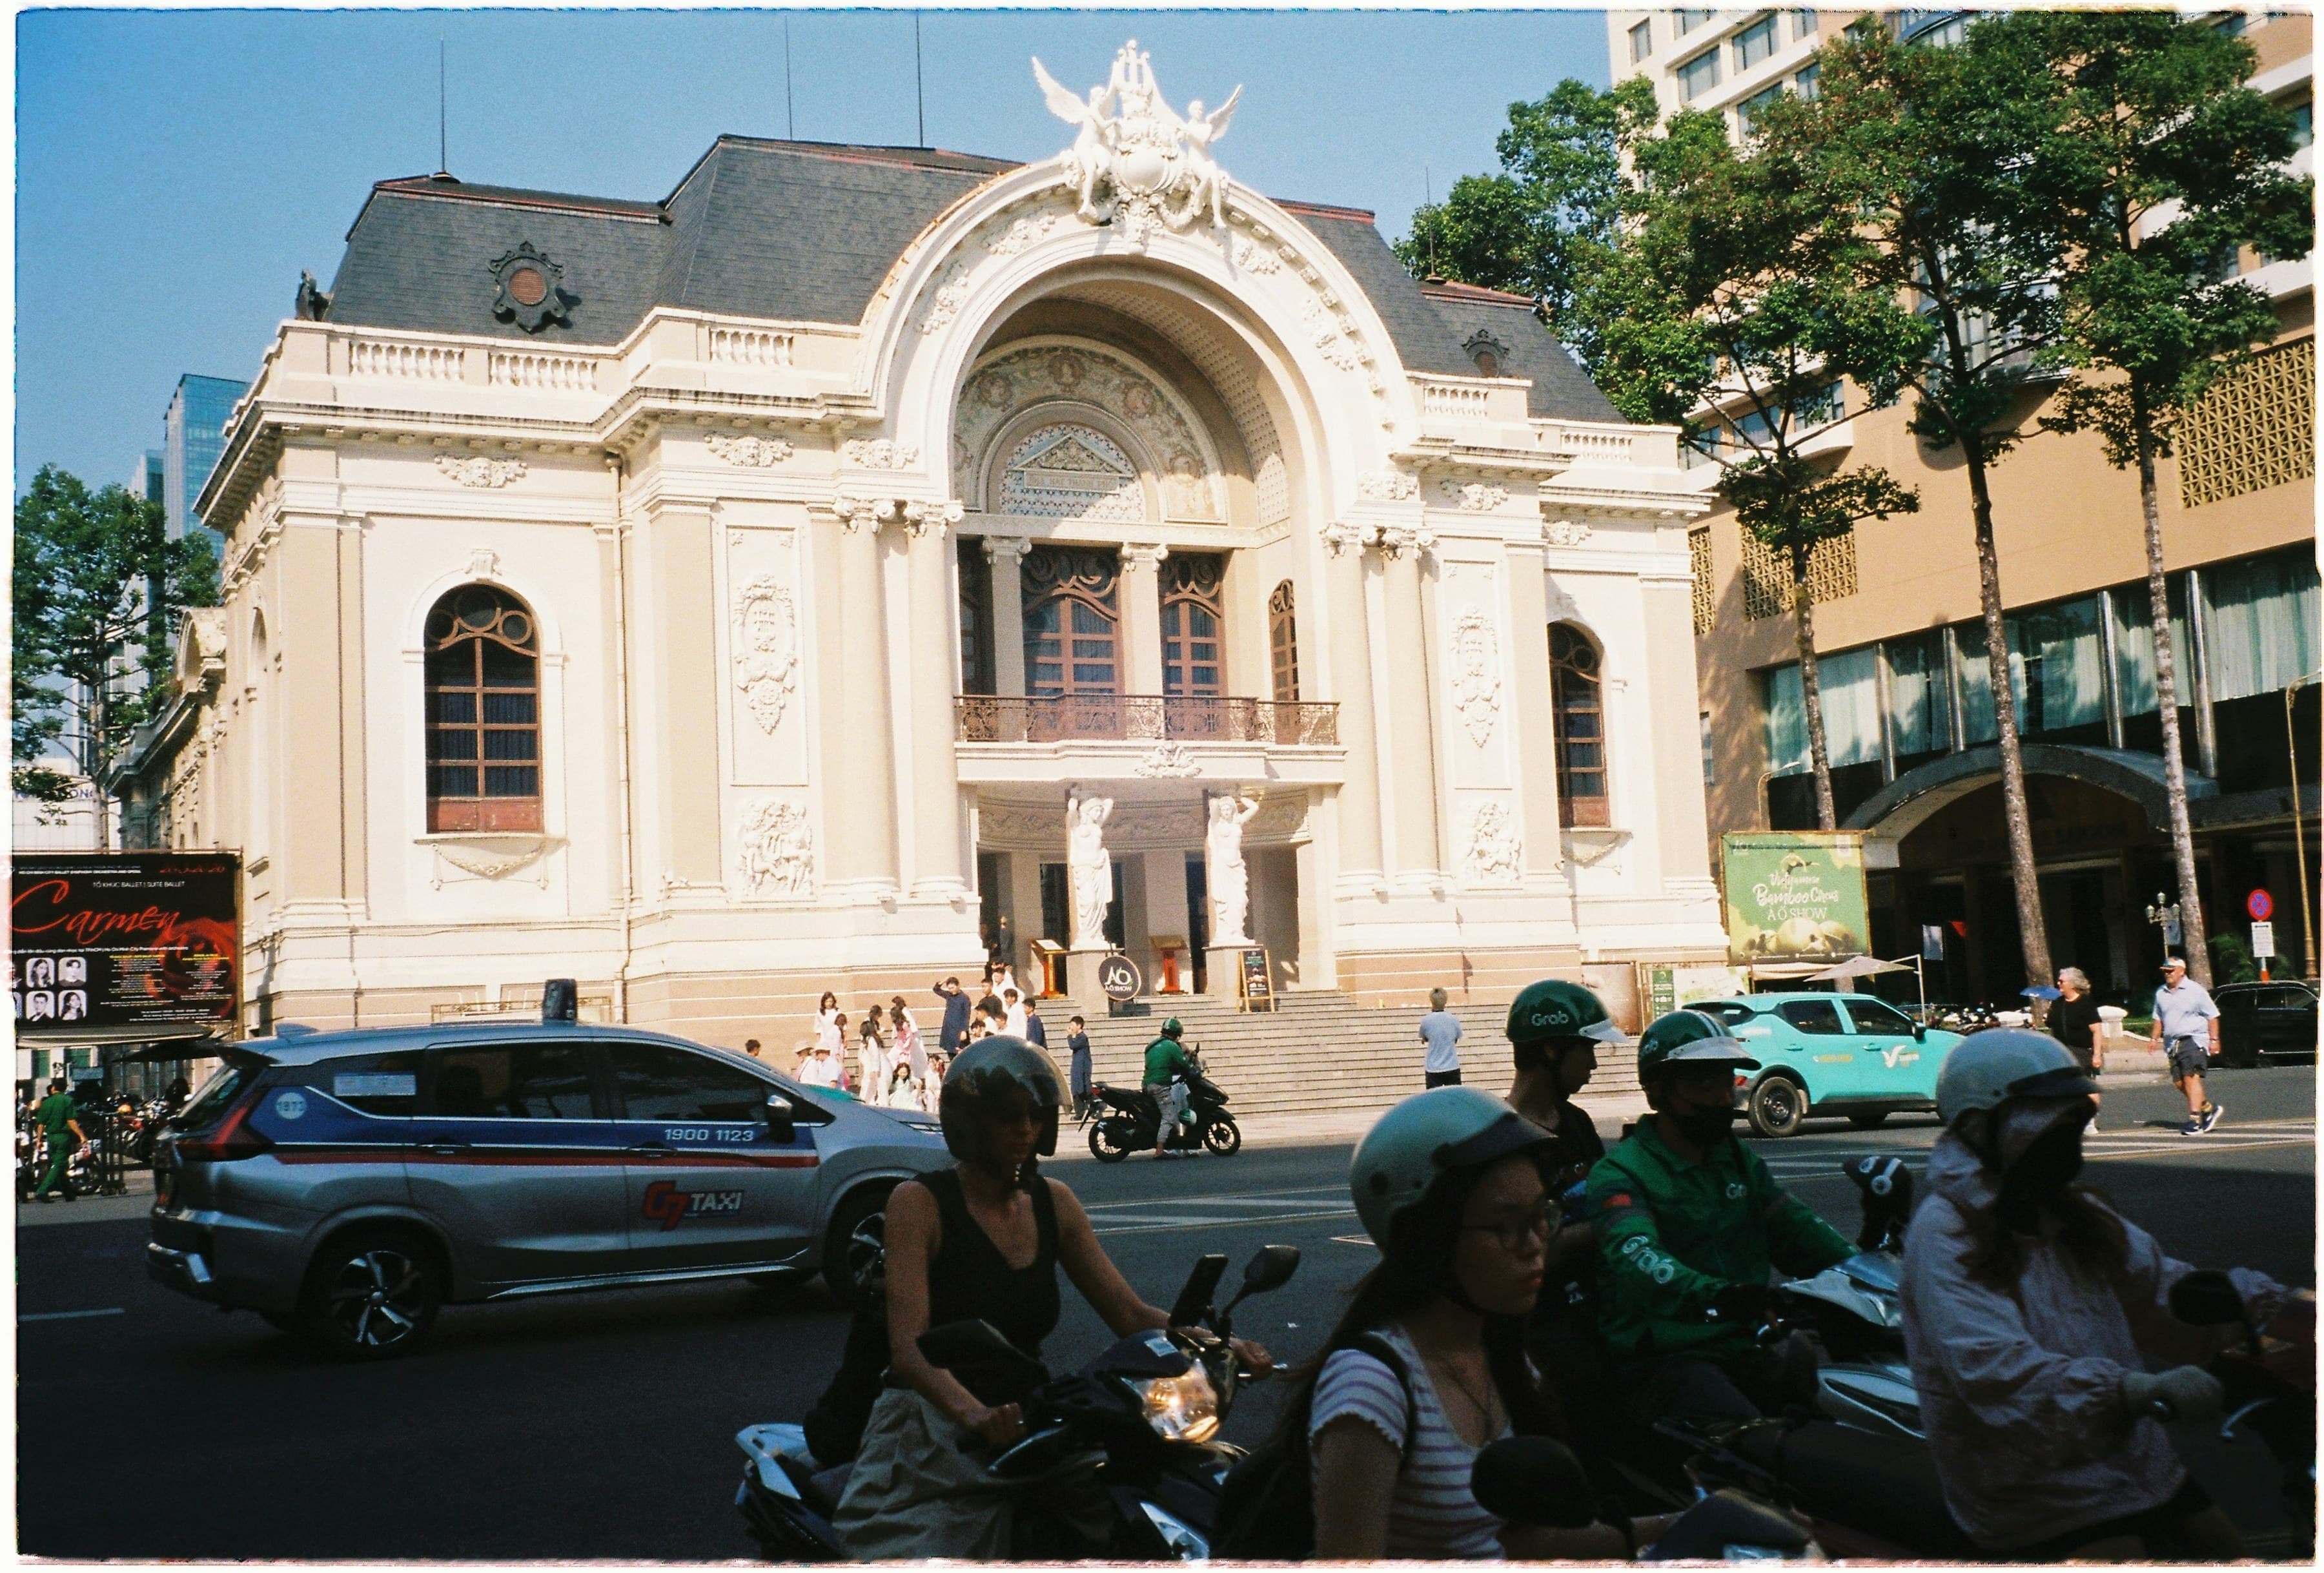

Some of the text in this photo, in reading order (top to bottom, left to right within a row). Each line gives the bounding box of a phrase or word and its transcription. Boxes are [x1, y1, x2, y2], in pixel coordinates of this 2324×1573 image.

[1752, 883, 1809, 906] Bamboo
[12, 879, 181, 945] Carmen
[1789, 907, 1827, 920] SHOW
[1531, 1011, 1569, 1027] Grab
[664, 1129, 754, 1142] 1900 1123
[690, 1192, 742, 1211] TAXI
[1621, 1235, 1675, 1284] Grab
